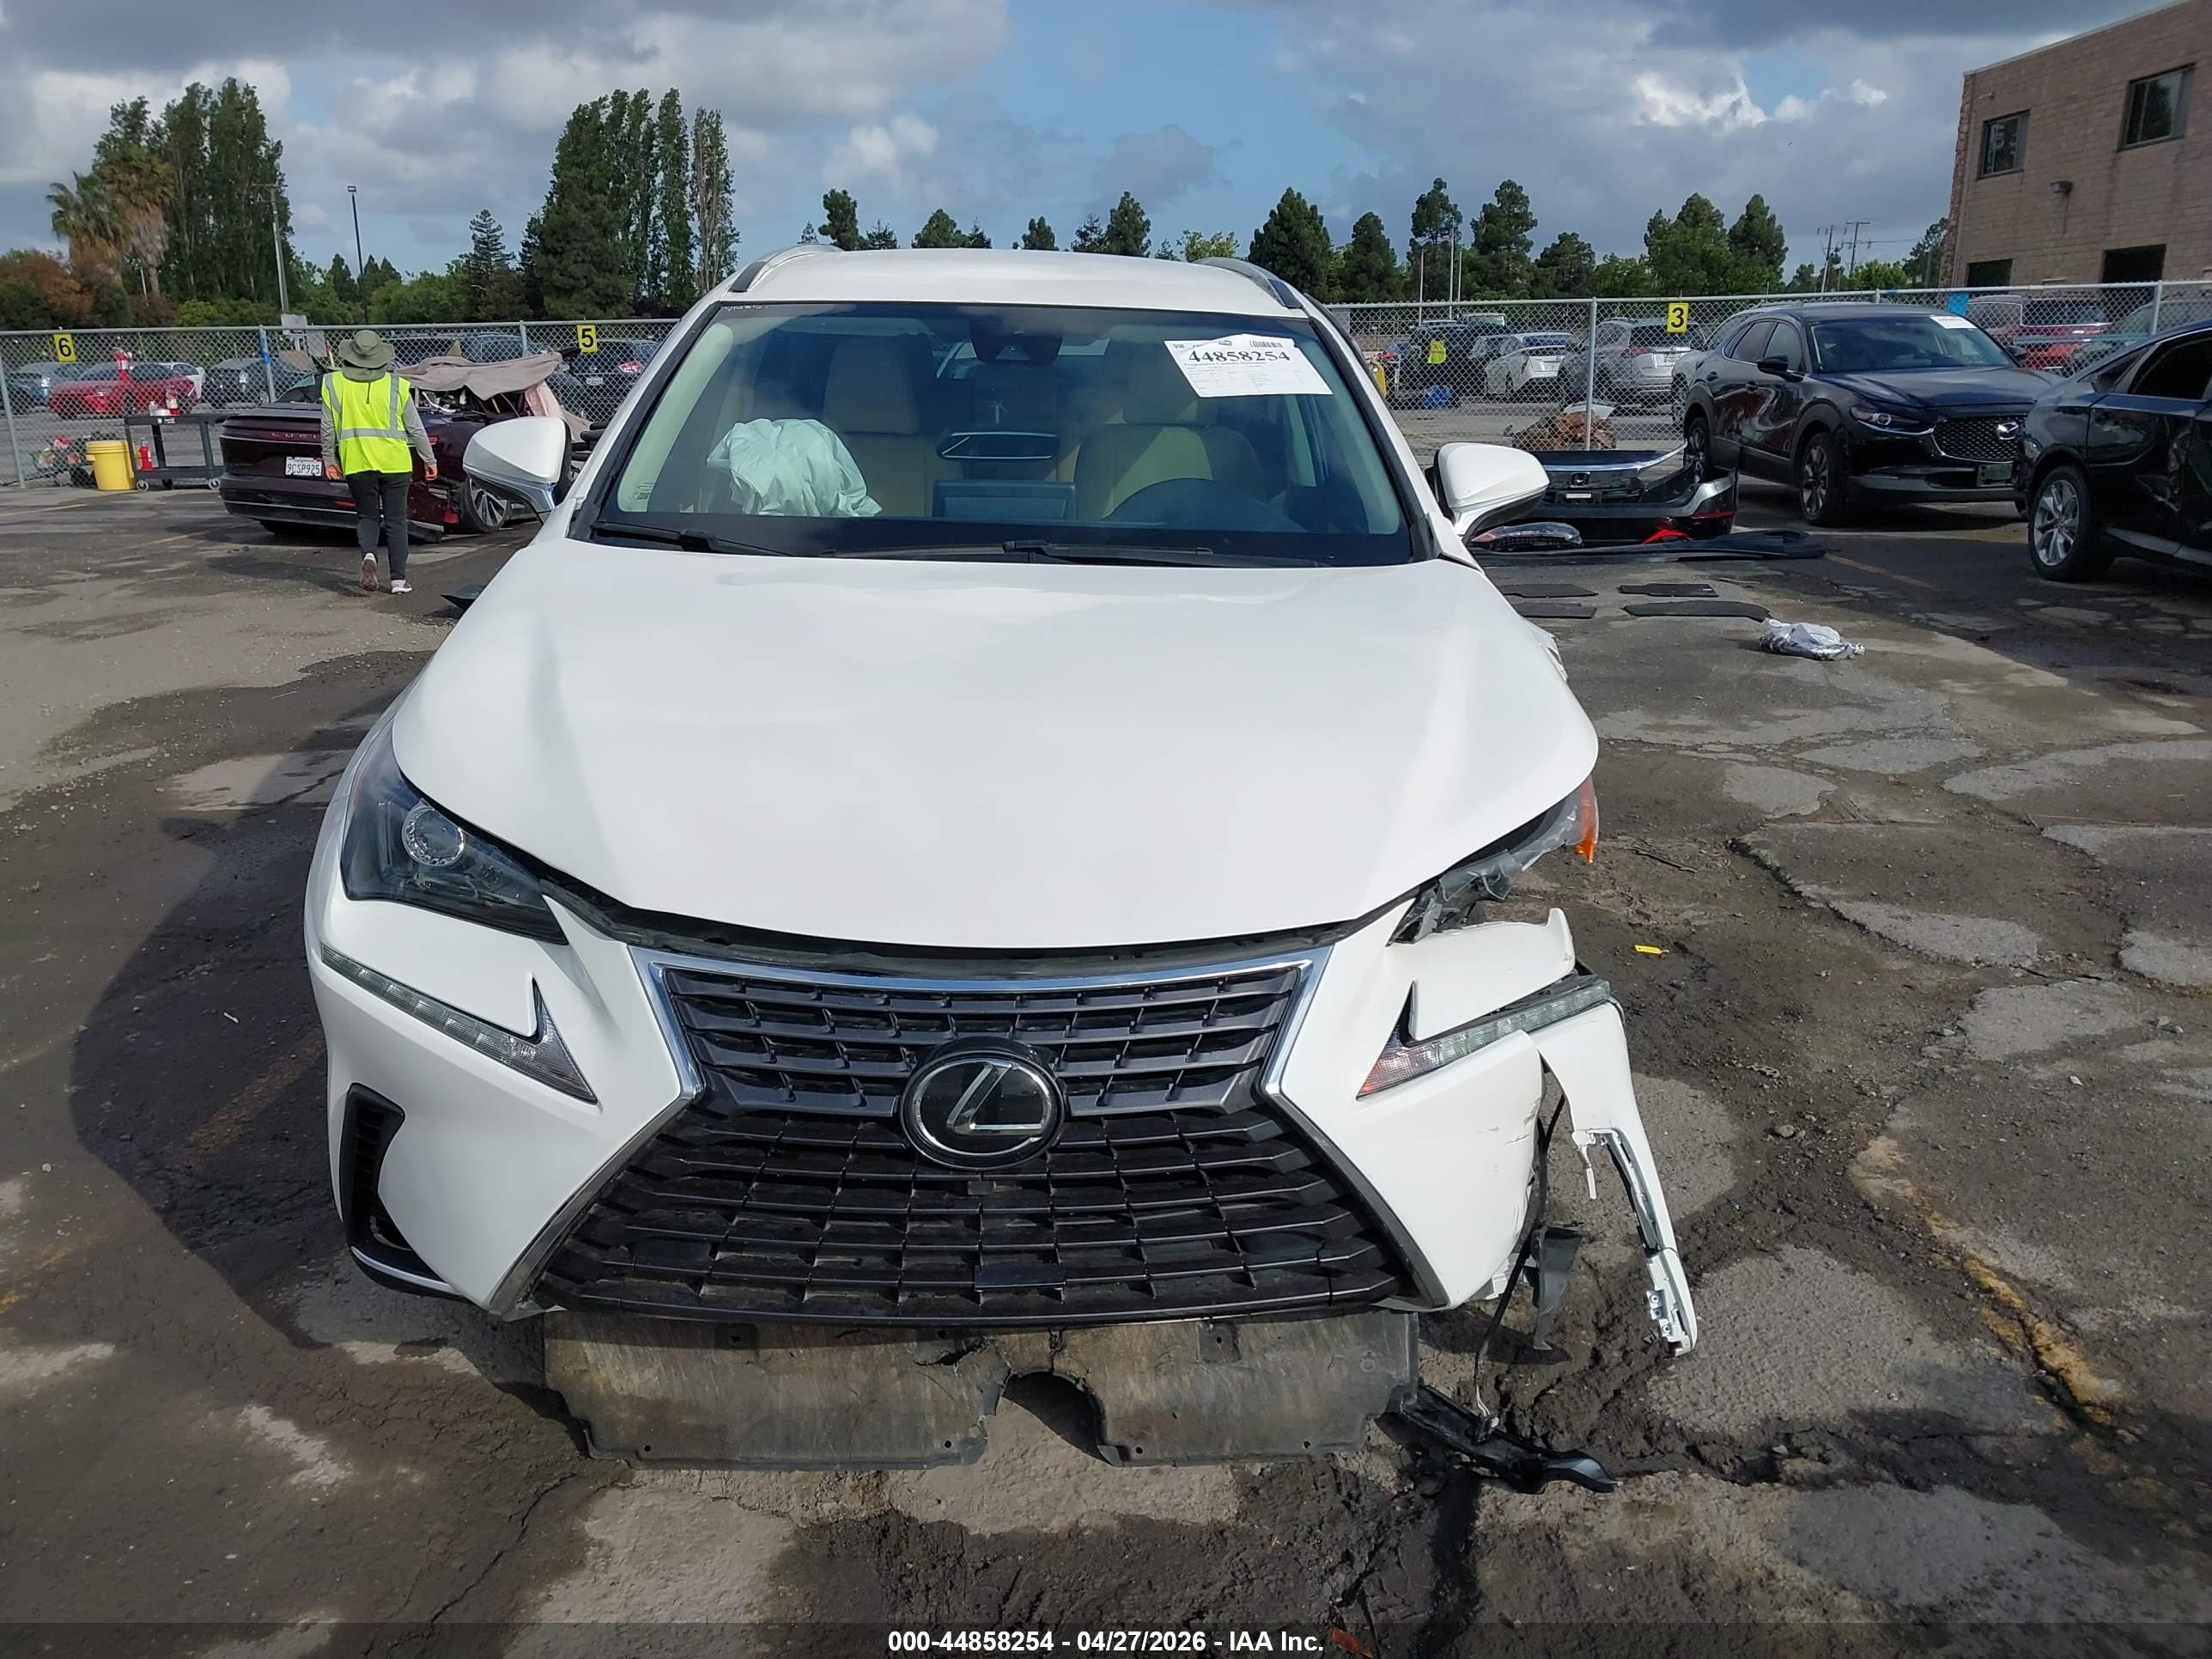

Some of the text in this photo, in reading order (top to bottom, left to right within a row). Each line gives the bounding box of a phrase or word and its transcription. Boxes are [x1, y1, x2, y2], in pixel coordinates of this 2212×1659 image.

[1671, 307, 1685, 328] 3
[58, 337, 71, 357] 6
[581, 328, 594, 348] 5
[1188, 350, 1291, 362] 44858254
